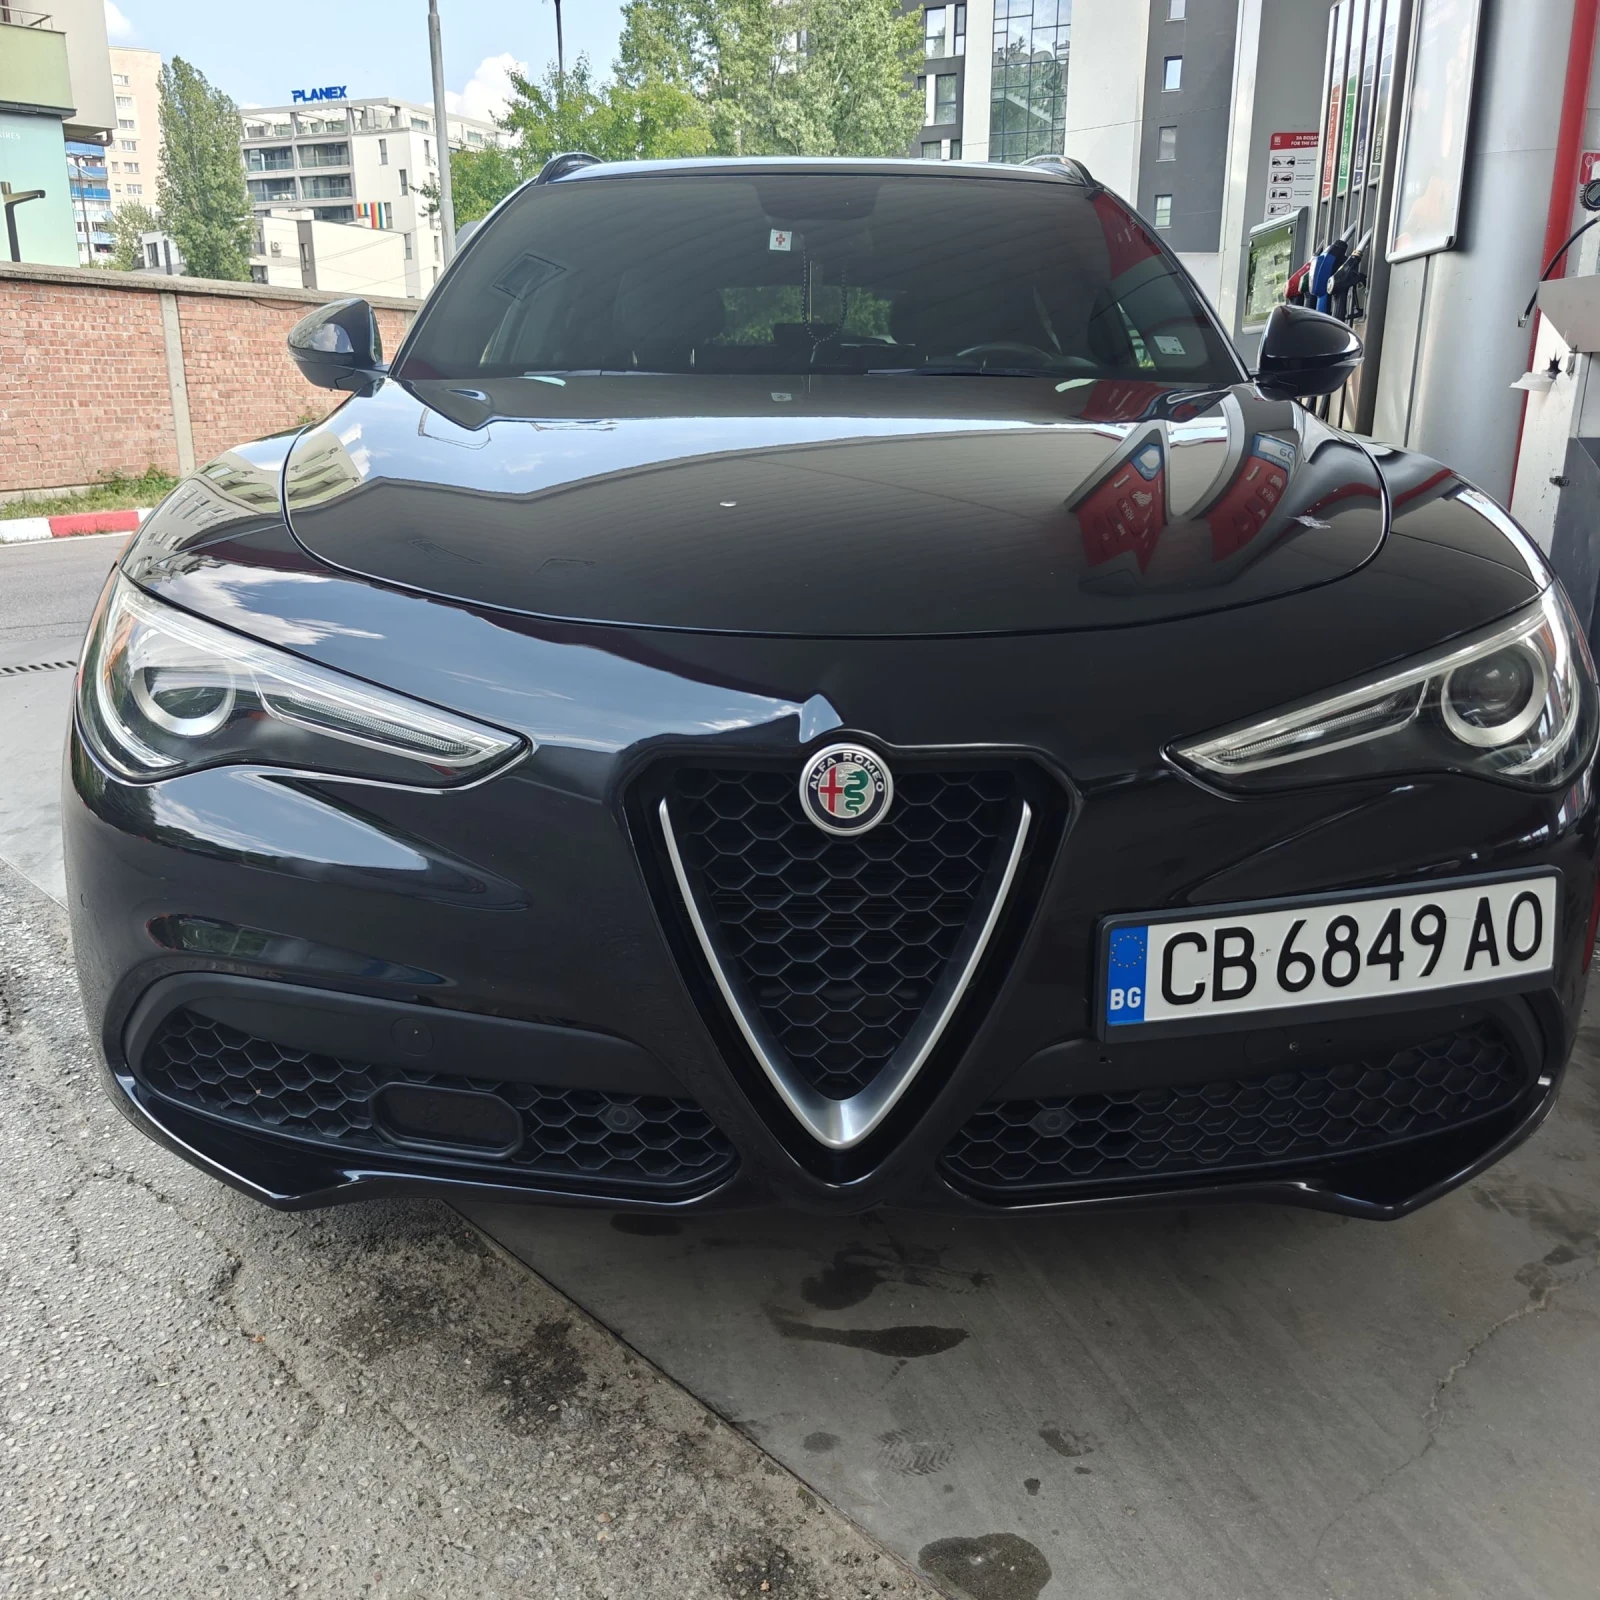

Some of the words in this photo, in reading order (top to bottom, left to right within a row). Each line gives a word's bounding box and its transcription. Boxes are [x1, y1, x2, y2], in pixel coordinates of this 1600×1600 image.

[291, 85, 347, 103] PLANEX
[810, 757, 836, 790] ALFA
[843, 753, 884, 792] ROMEO
[1161, 926, 1257, 1006] CB
[1276, 903, 1447, 993] 6849
[1463, 890, 1543, 971] AO
[1110, 986, 1141, 1011] BG
